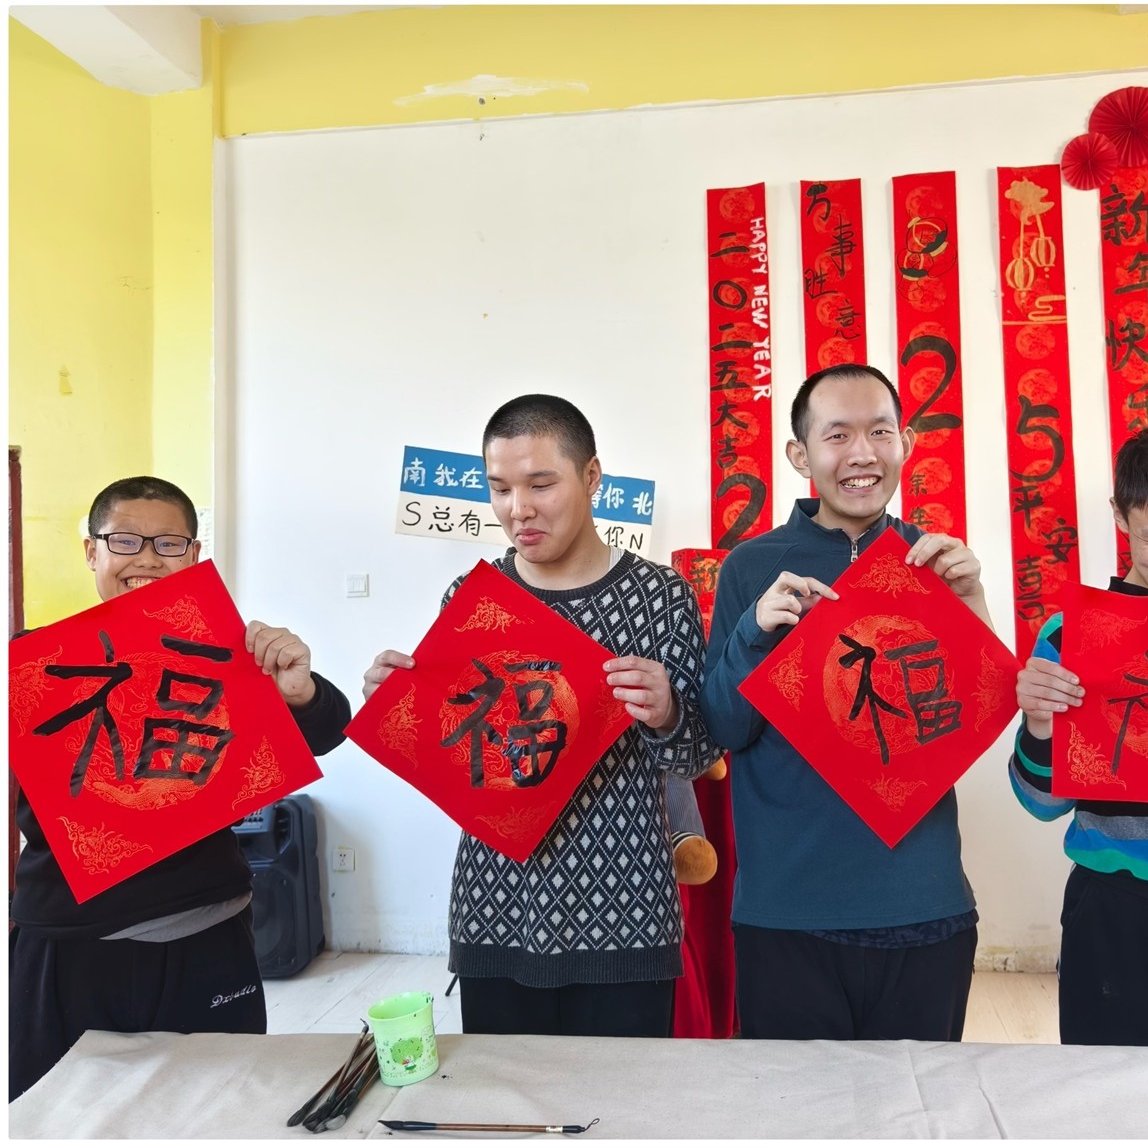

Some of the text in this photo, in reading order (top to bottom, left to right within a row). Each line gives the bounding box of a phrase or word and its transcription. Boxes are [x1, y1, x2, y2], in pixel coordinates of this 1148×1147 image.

[750, 216, 773, 401] HAPPY NEW YEAR
[901, 334, 963, 433] 2
[1010, 394, 1066, 483] 5
[402, 501, 421, 526] S
[629, 533, 643, 550] N
[403, 457, 426, 486] 南
[632, 491, 652, 516] 北
[33, 631, 234, 798] 福
[440, 658, 567, 789] 福
[838, 634, 962, 766] 福
